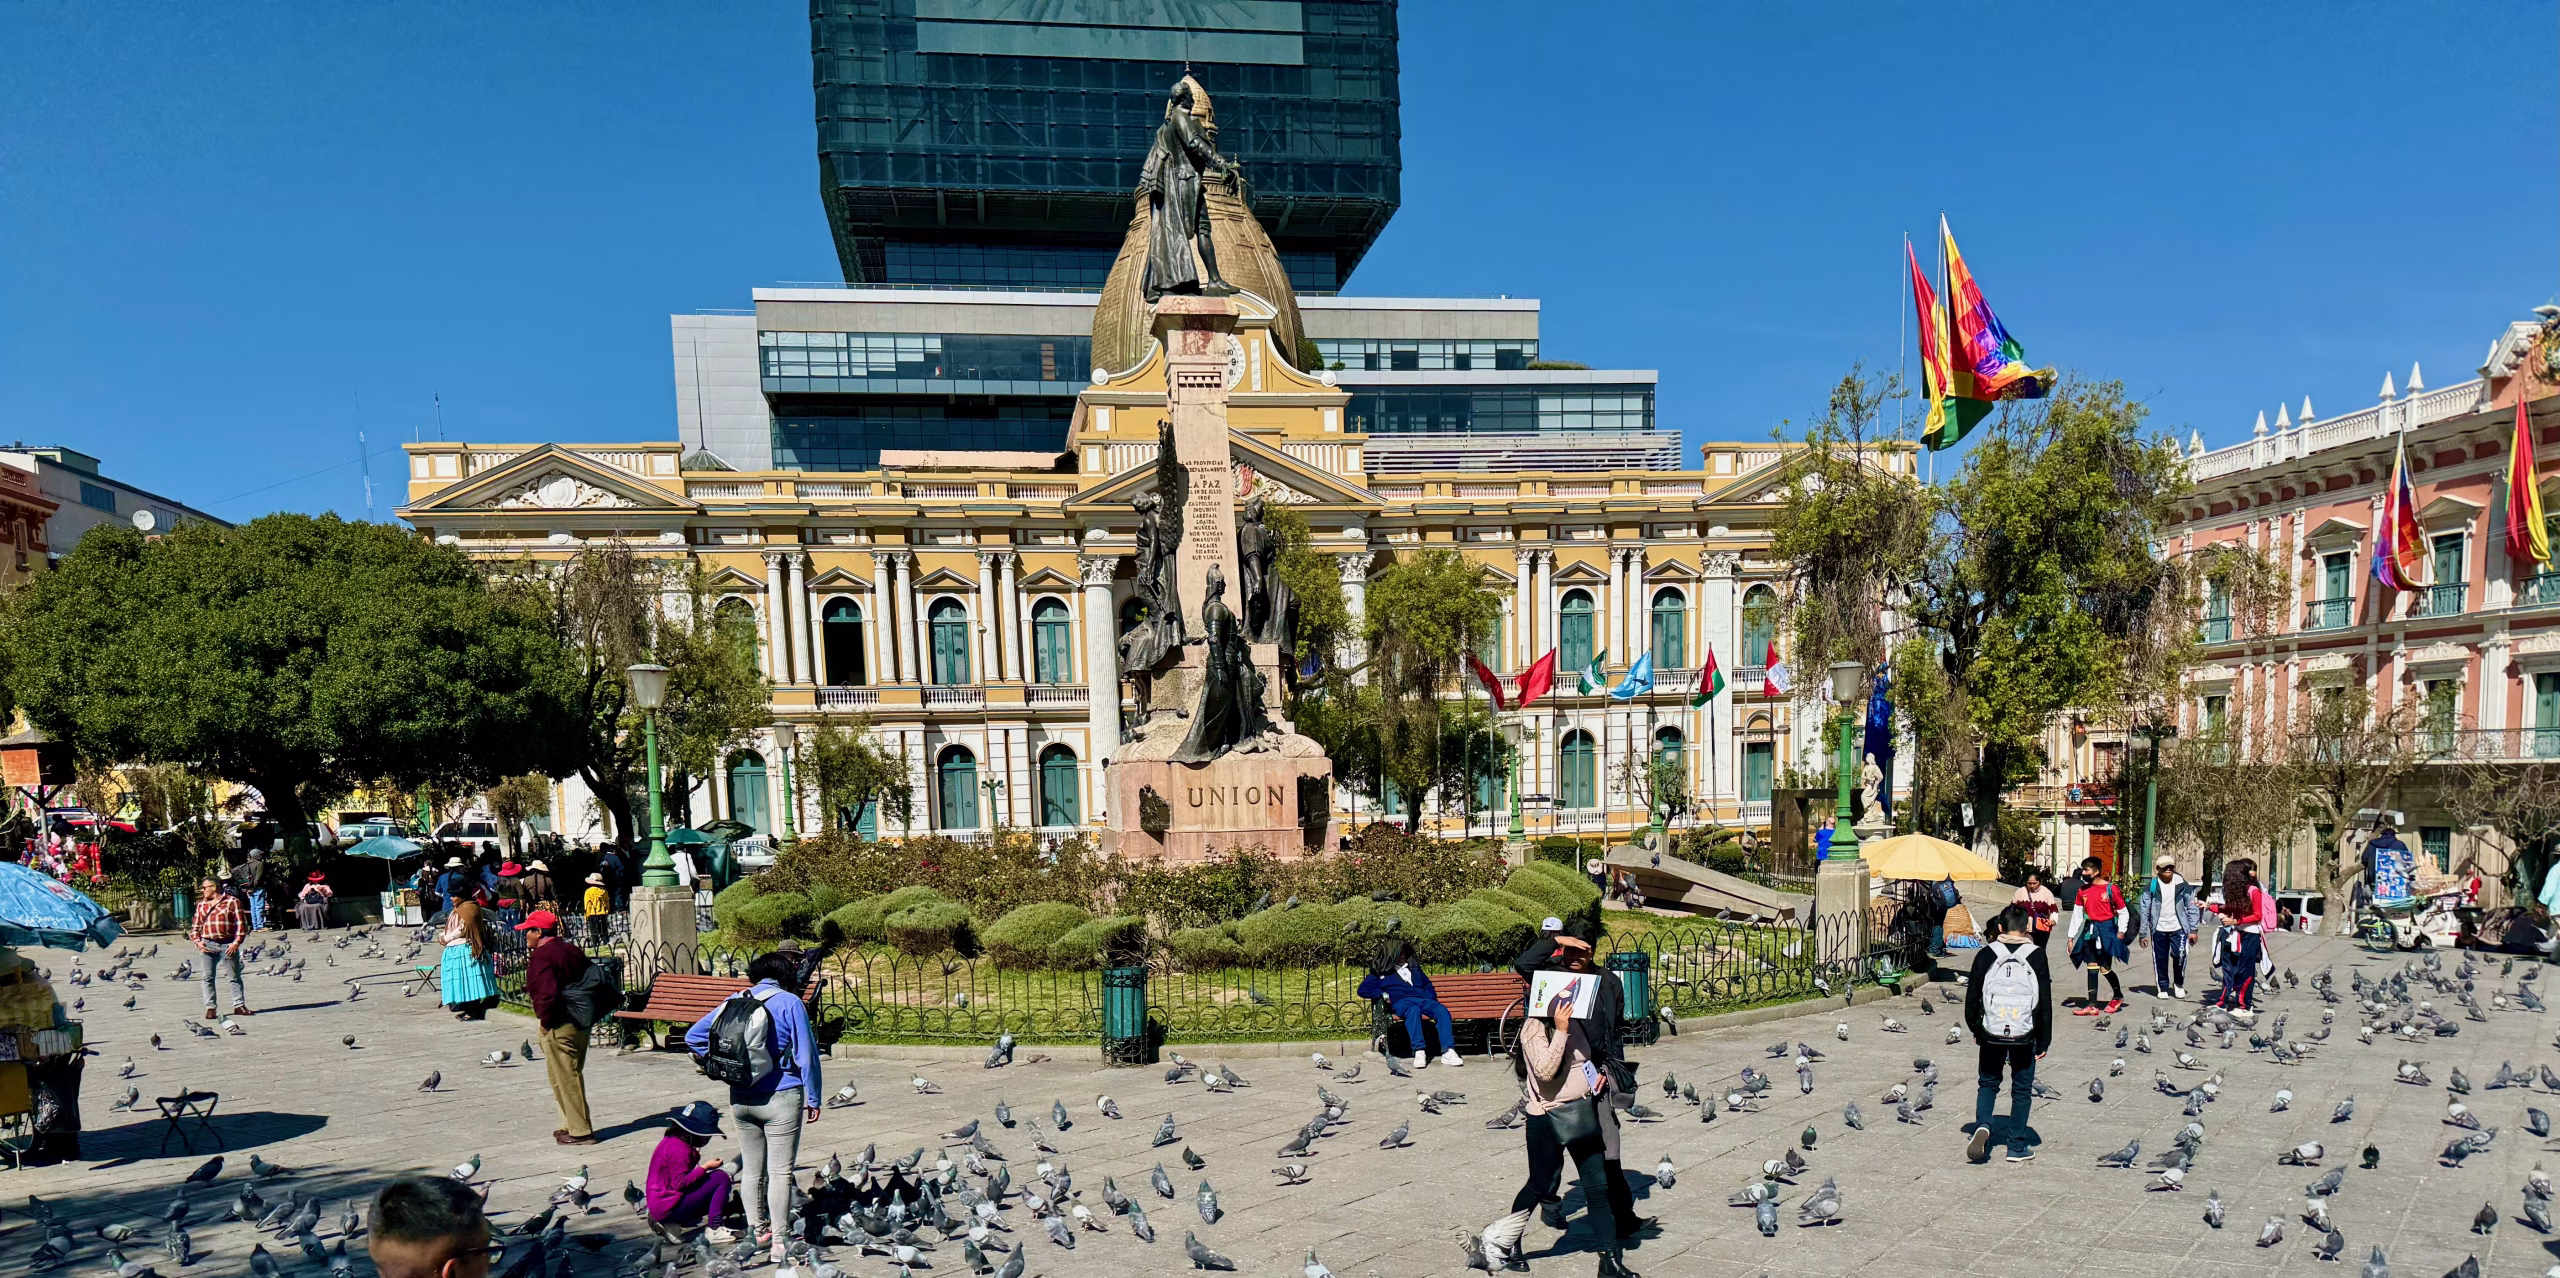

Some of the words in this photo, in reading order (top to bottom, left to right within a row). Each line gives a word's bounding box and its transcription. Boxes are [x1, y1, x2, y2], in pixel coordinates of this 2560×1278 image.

[1231, 358, 1236, 366] 9
[1202, 480, 1221, 489] PAZ
[1188, 786, 1285, 807] UNION
